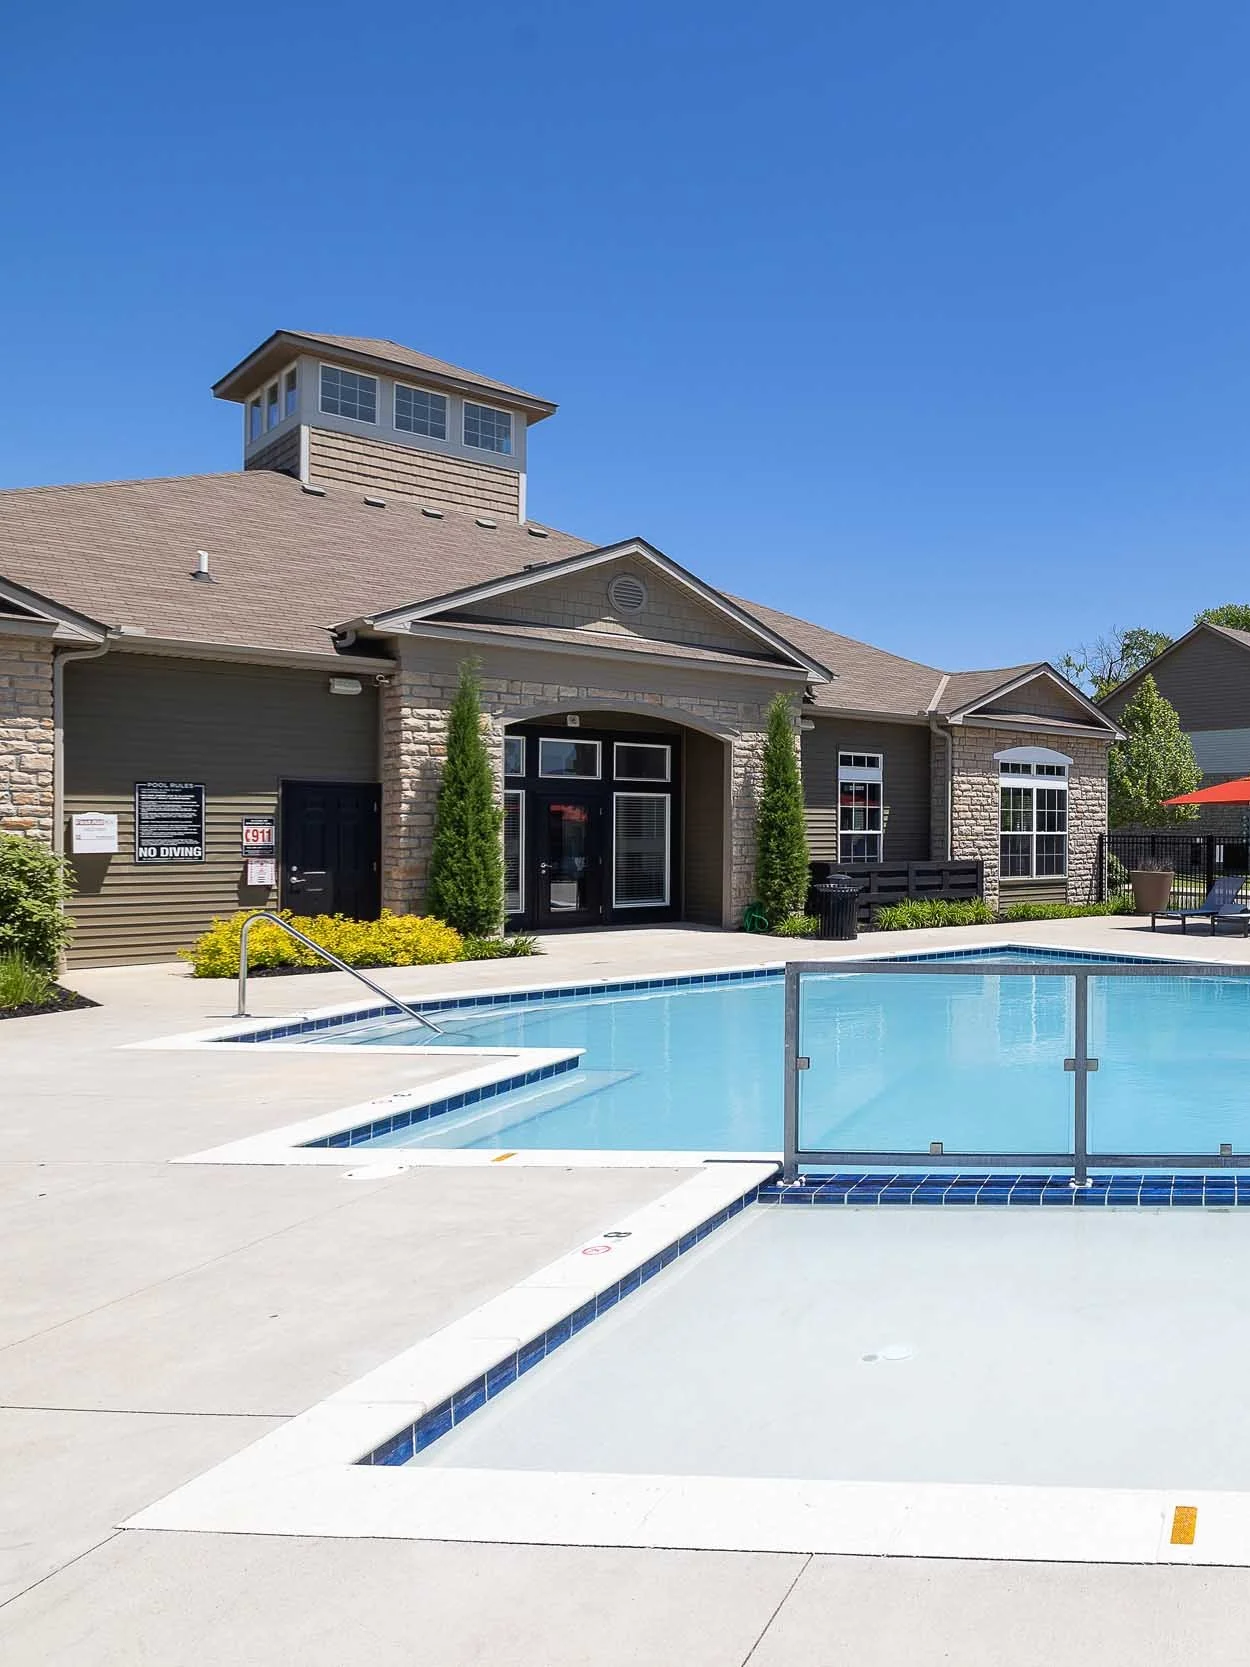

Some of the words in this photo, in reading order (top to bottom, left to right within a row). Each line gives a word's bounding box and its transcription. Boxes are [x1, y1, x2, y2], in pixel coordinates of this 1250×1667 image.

[252, 829, 272, 842] 911
[139, 847, 157, 857] NO
[160, 846, 202, 857] DIVING
